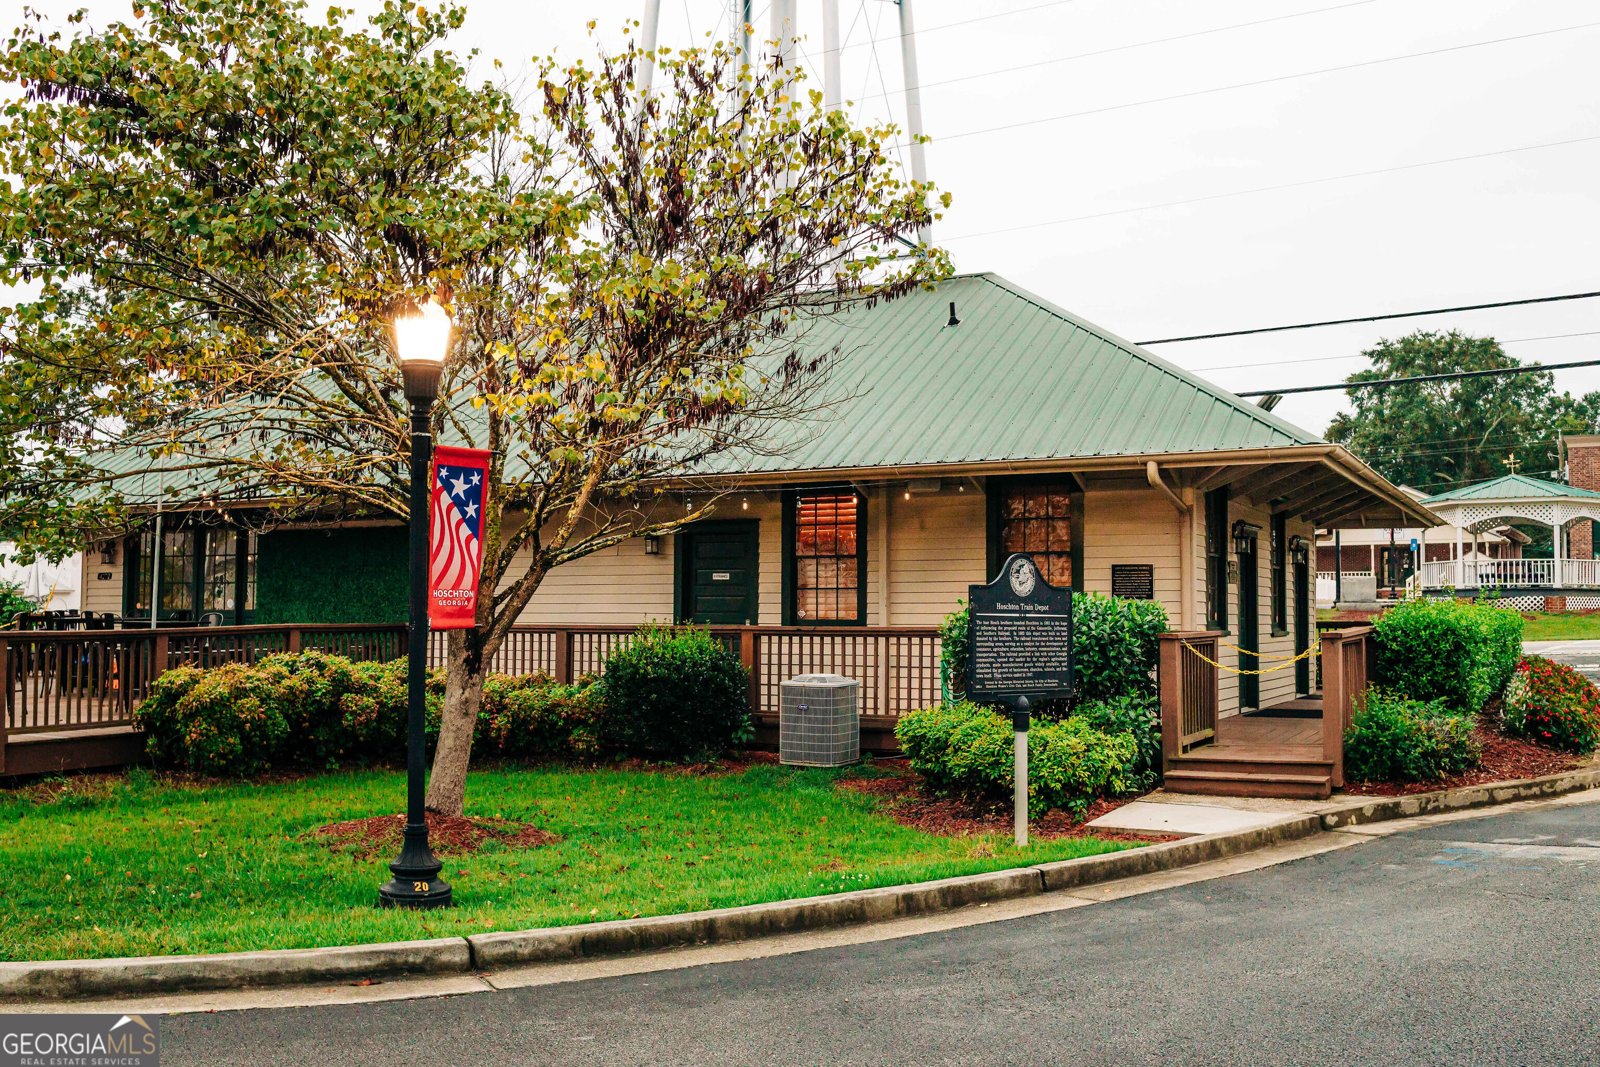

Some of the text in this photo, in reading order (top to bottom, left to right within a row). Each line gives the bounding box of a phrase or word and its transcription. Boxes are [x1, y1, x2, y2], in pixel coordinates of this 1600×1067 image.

[433, 590, 474, 598] HOSCHTON
[1034, 604, 1049, 612] Depot
[414, 882, 429, 892] 20
